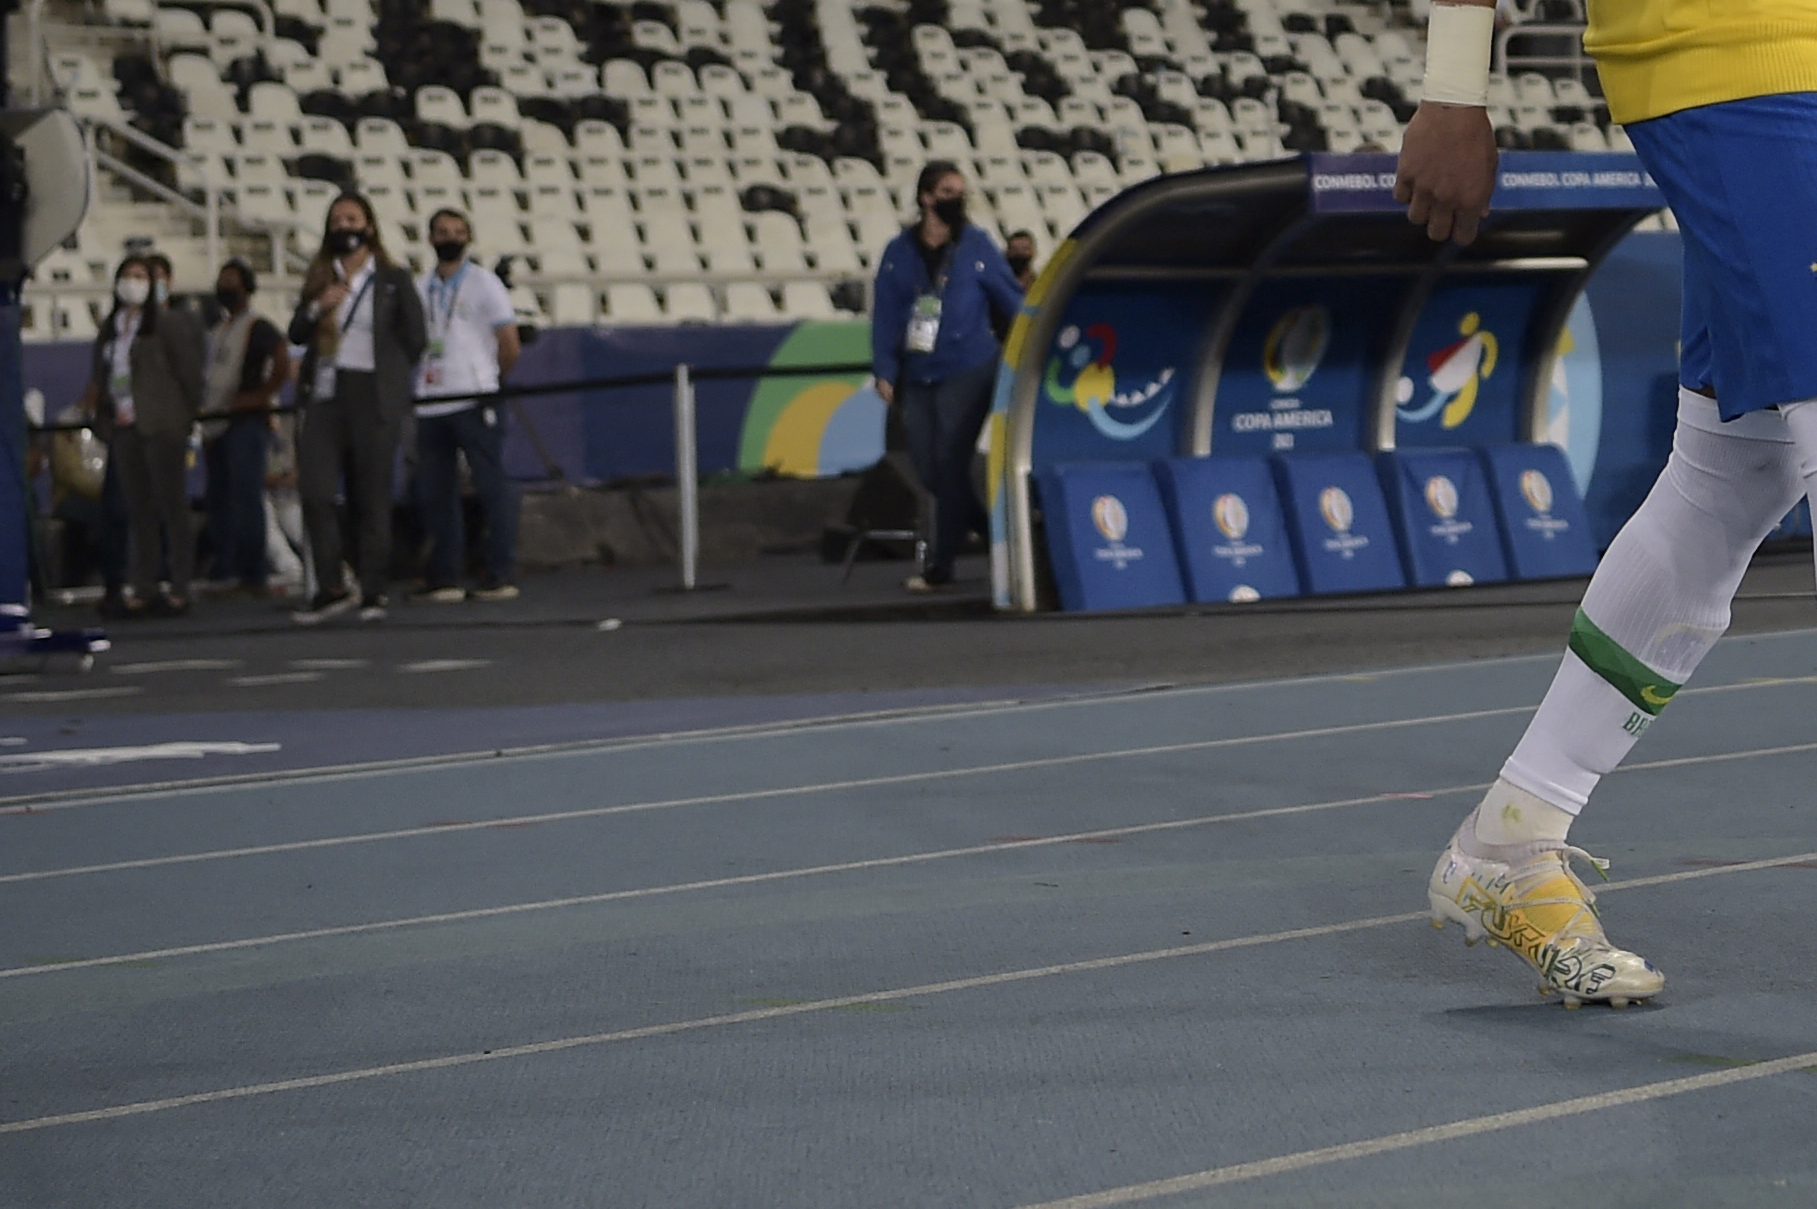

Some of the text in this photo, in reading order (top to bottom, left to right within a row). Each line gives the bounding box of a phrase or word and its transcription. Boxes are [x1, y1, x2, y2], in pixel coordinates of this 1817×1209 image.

[1314, 174, 1378, 189] CONMEBOL
[1233, 409, 1334, 431] COPA AMERICA
